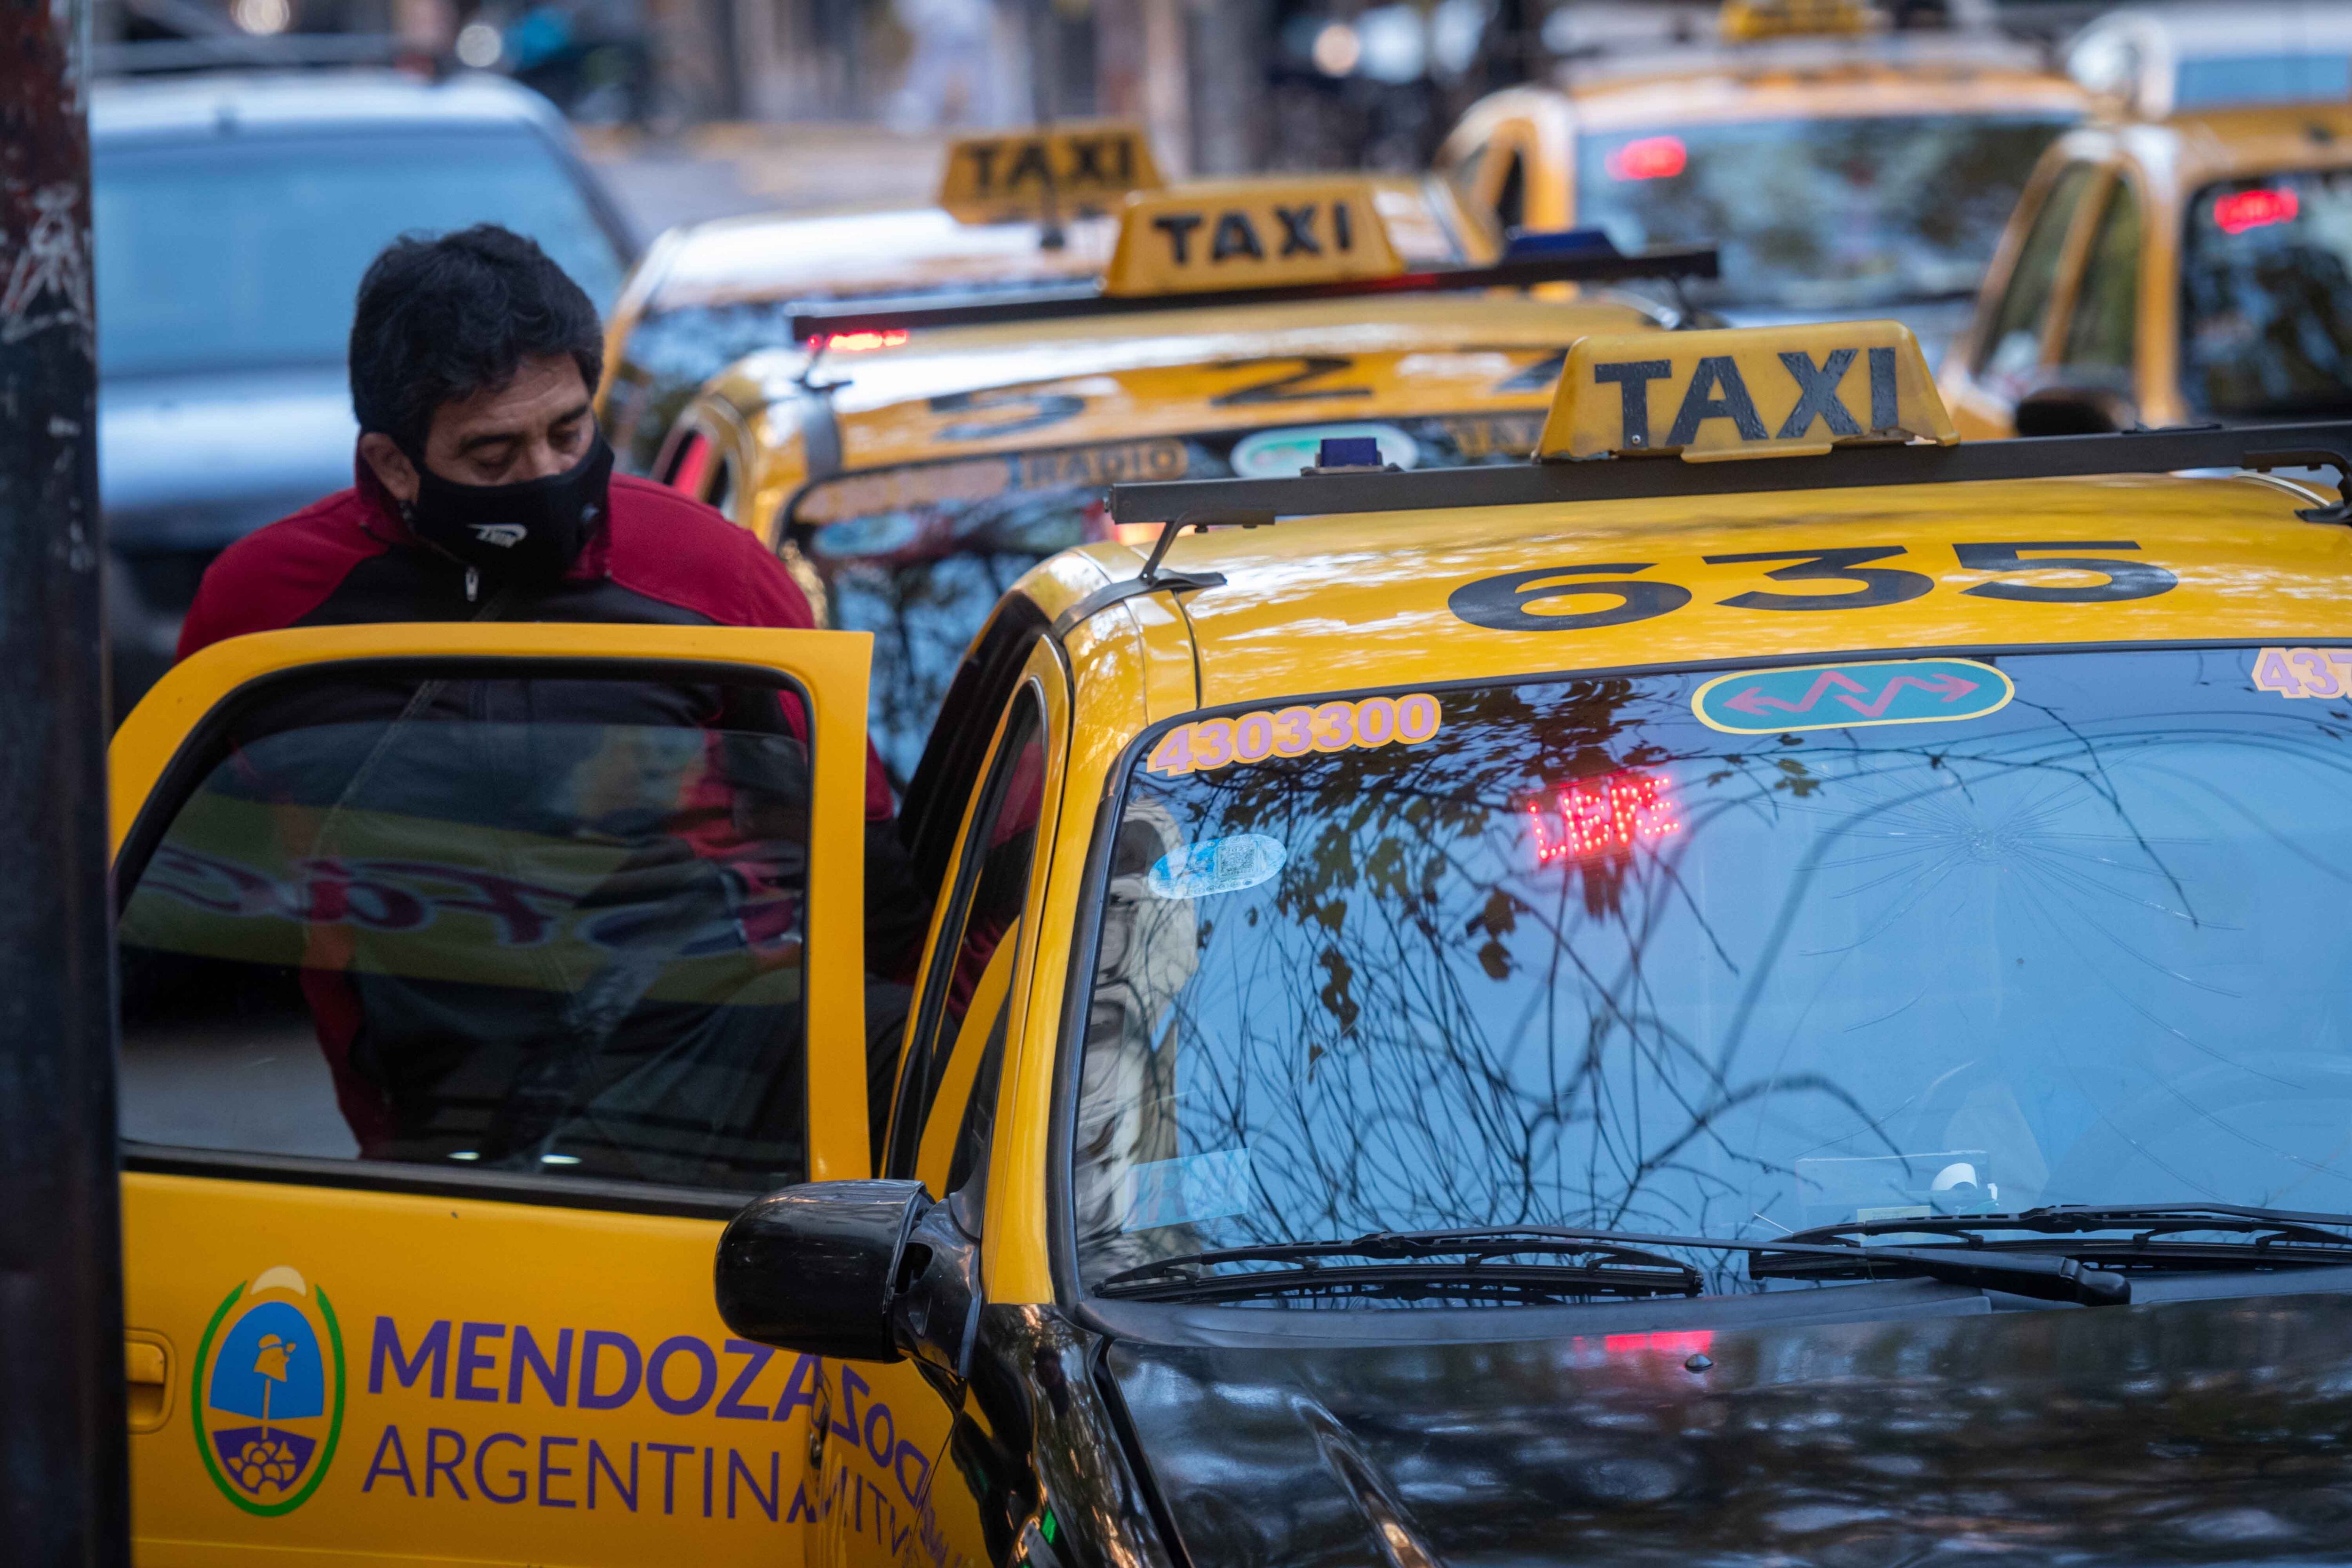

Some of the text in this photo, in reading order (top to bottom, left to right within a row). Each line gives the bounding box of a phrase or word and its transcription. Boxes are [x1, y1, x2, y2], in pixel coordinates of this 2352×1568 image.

[970, 136, 1133, 195] TAXI
[1152, 201, 1353, 266] TAXI
[1594, 347, 1899, 449] TAXI
[1448, 540, 2179, 632] 635
[1155, 696, 1435, 772] 4303300
[367, 1315, 823, 1422] MENDOZA
